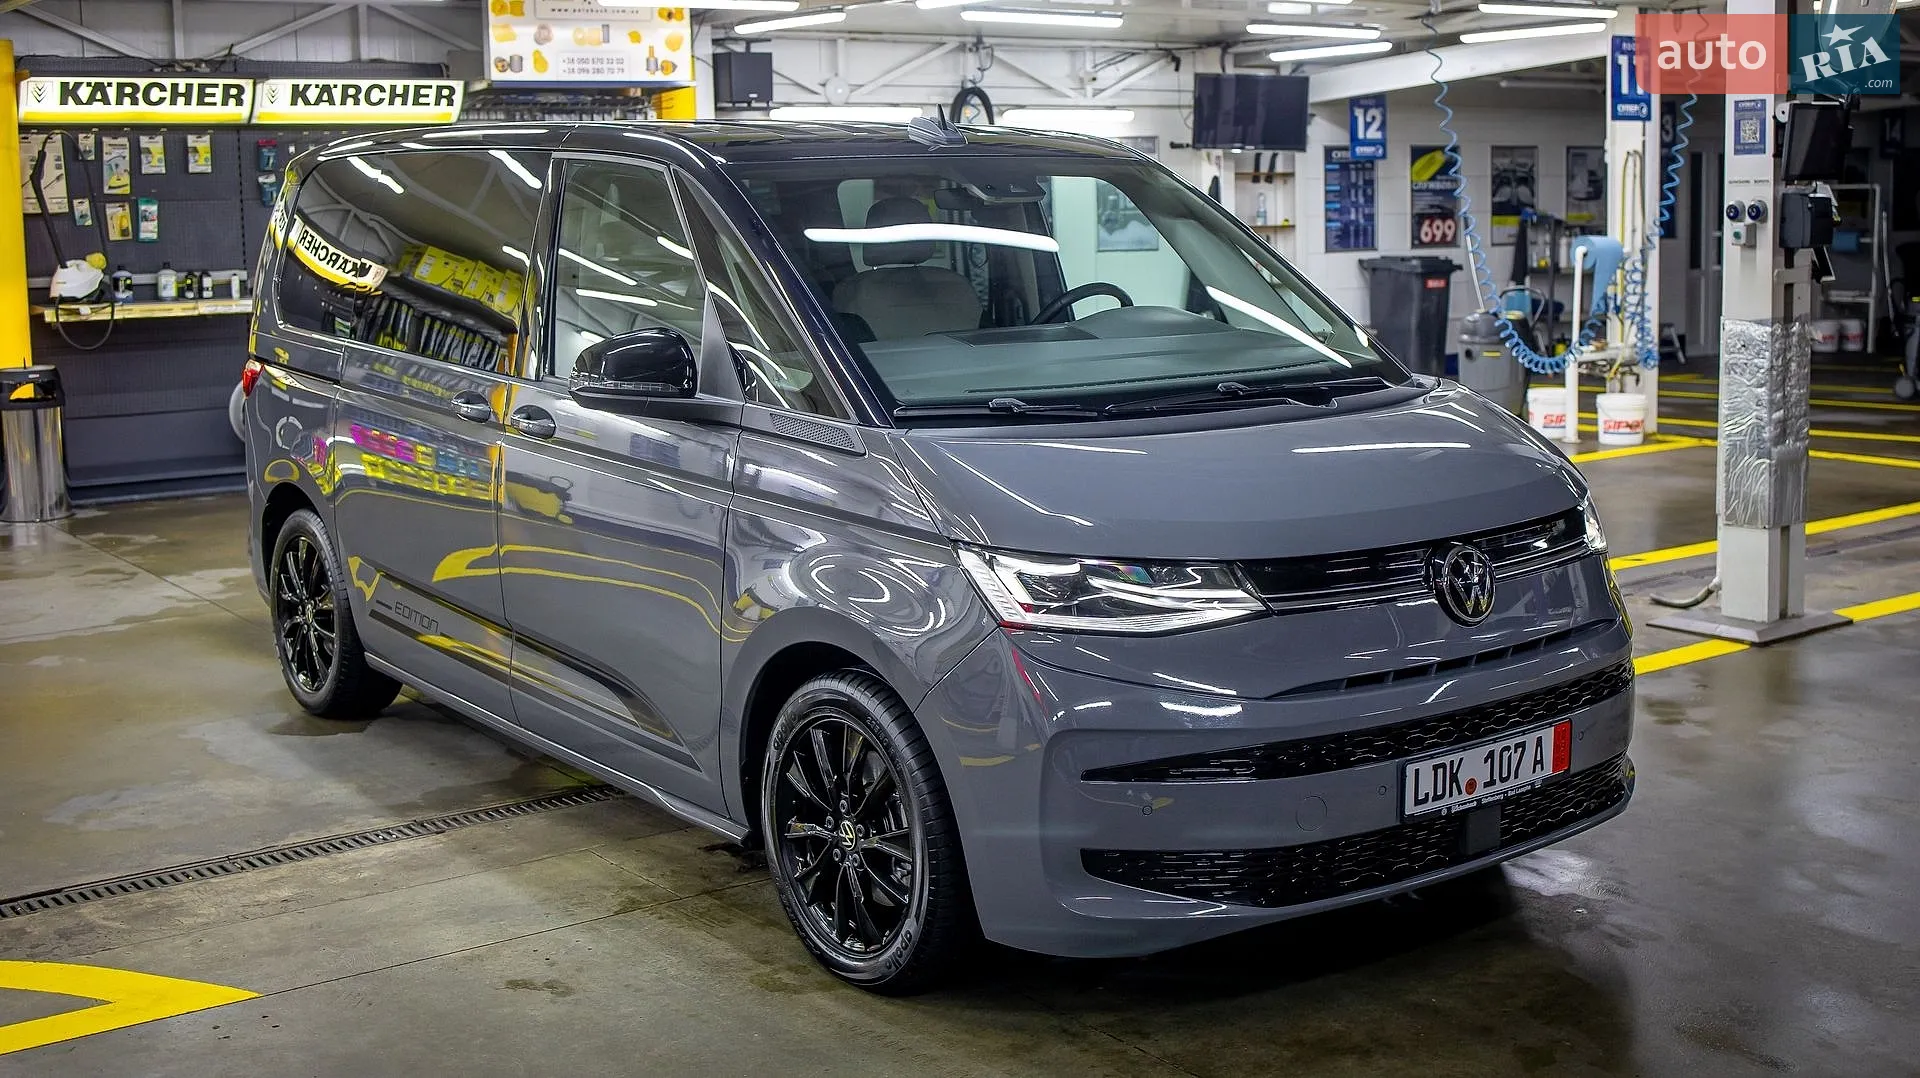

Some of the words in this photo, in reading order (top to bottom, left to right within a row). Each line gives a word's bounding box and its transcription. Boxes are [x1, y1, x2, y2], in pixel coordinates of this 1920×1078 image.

[58, 81, 246, 107] KÄRCHER
[289, 83, 456, 107] KÄRCHER
[1353, 107, 1383, 140] 12
[1420, 218, 1456, 244] 699
[394, 601, 439, 633] EDITION
[1413, 756, 1464, 807] LDK
[1482, 740, 1527, 789] 107
[1532, 735, 1545, 774] A
